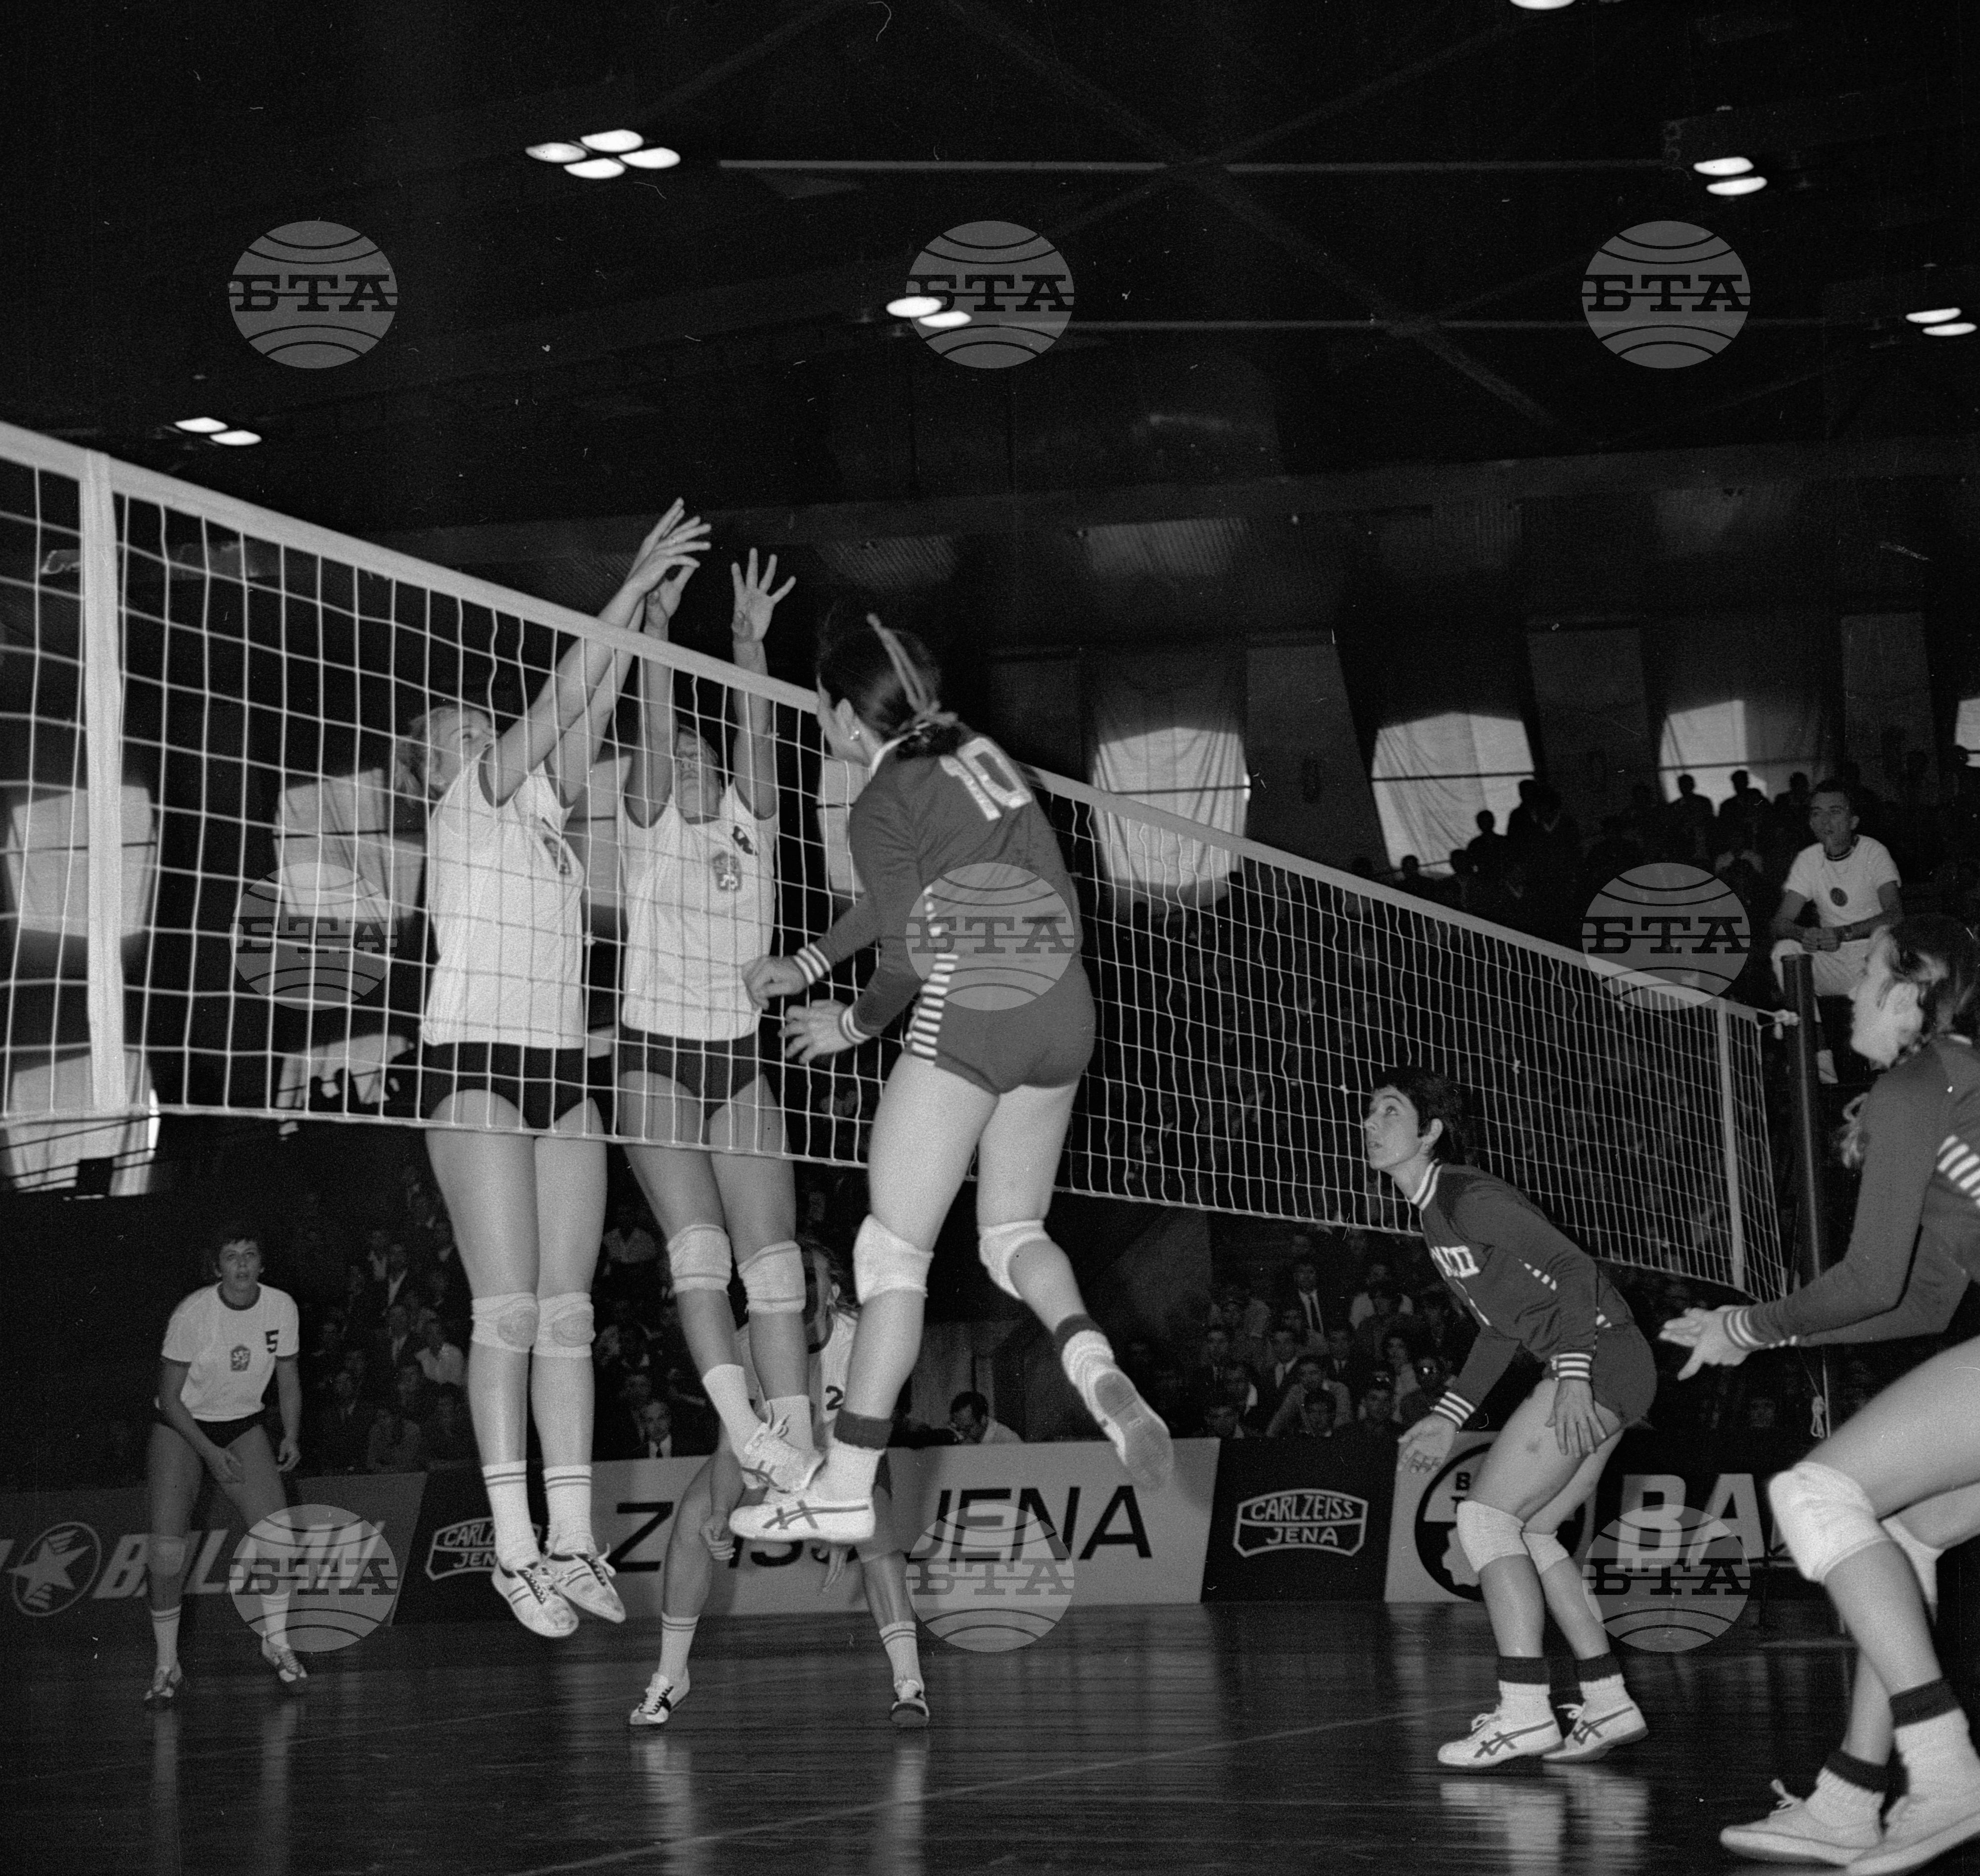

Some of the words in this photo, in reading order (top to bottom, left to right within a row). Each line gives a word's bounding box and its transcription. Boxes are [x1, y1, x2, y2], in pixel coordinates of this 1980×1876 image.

[940, 737, 1032, 821] 10
[265, 1330, 279, 1353] 5
[825, 1385, 843, 1411] 2
[904, 1485, 1152, 1562] JENA
[1616, 1473, 1787, 1569] BA
[1266, 1527, 1337, 1546] JENA
[453, 1552, 496, 1569] JEN
